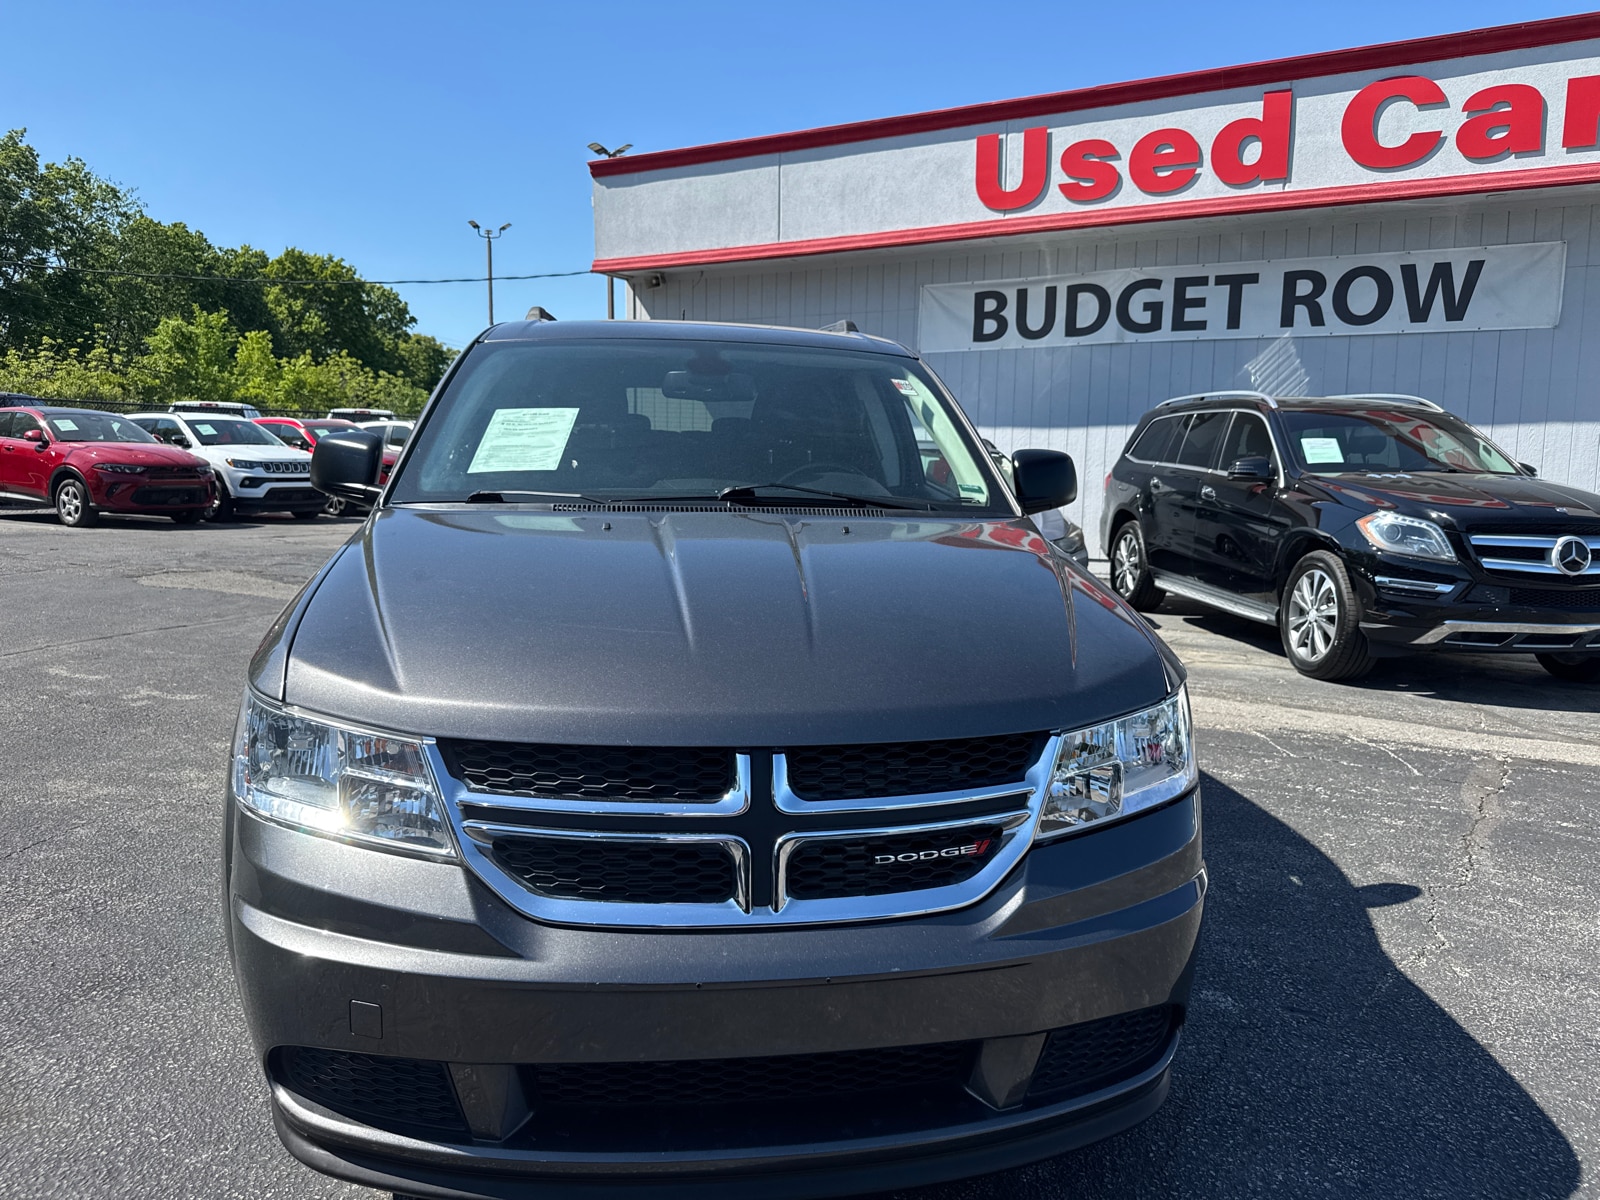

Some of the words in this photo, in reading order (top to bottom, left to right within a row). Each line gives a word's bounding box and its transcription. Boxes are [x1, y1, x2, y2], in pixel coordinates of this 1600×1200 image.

[975, 89, 1293, 210] Used
[972, 272, 1259, 343] BUDGET
[1280, 260, 1486, 329] ROW
[874, 844, 978, 865] DODGE
